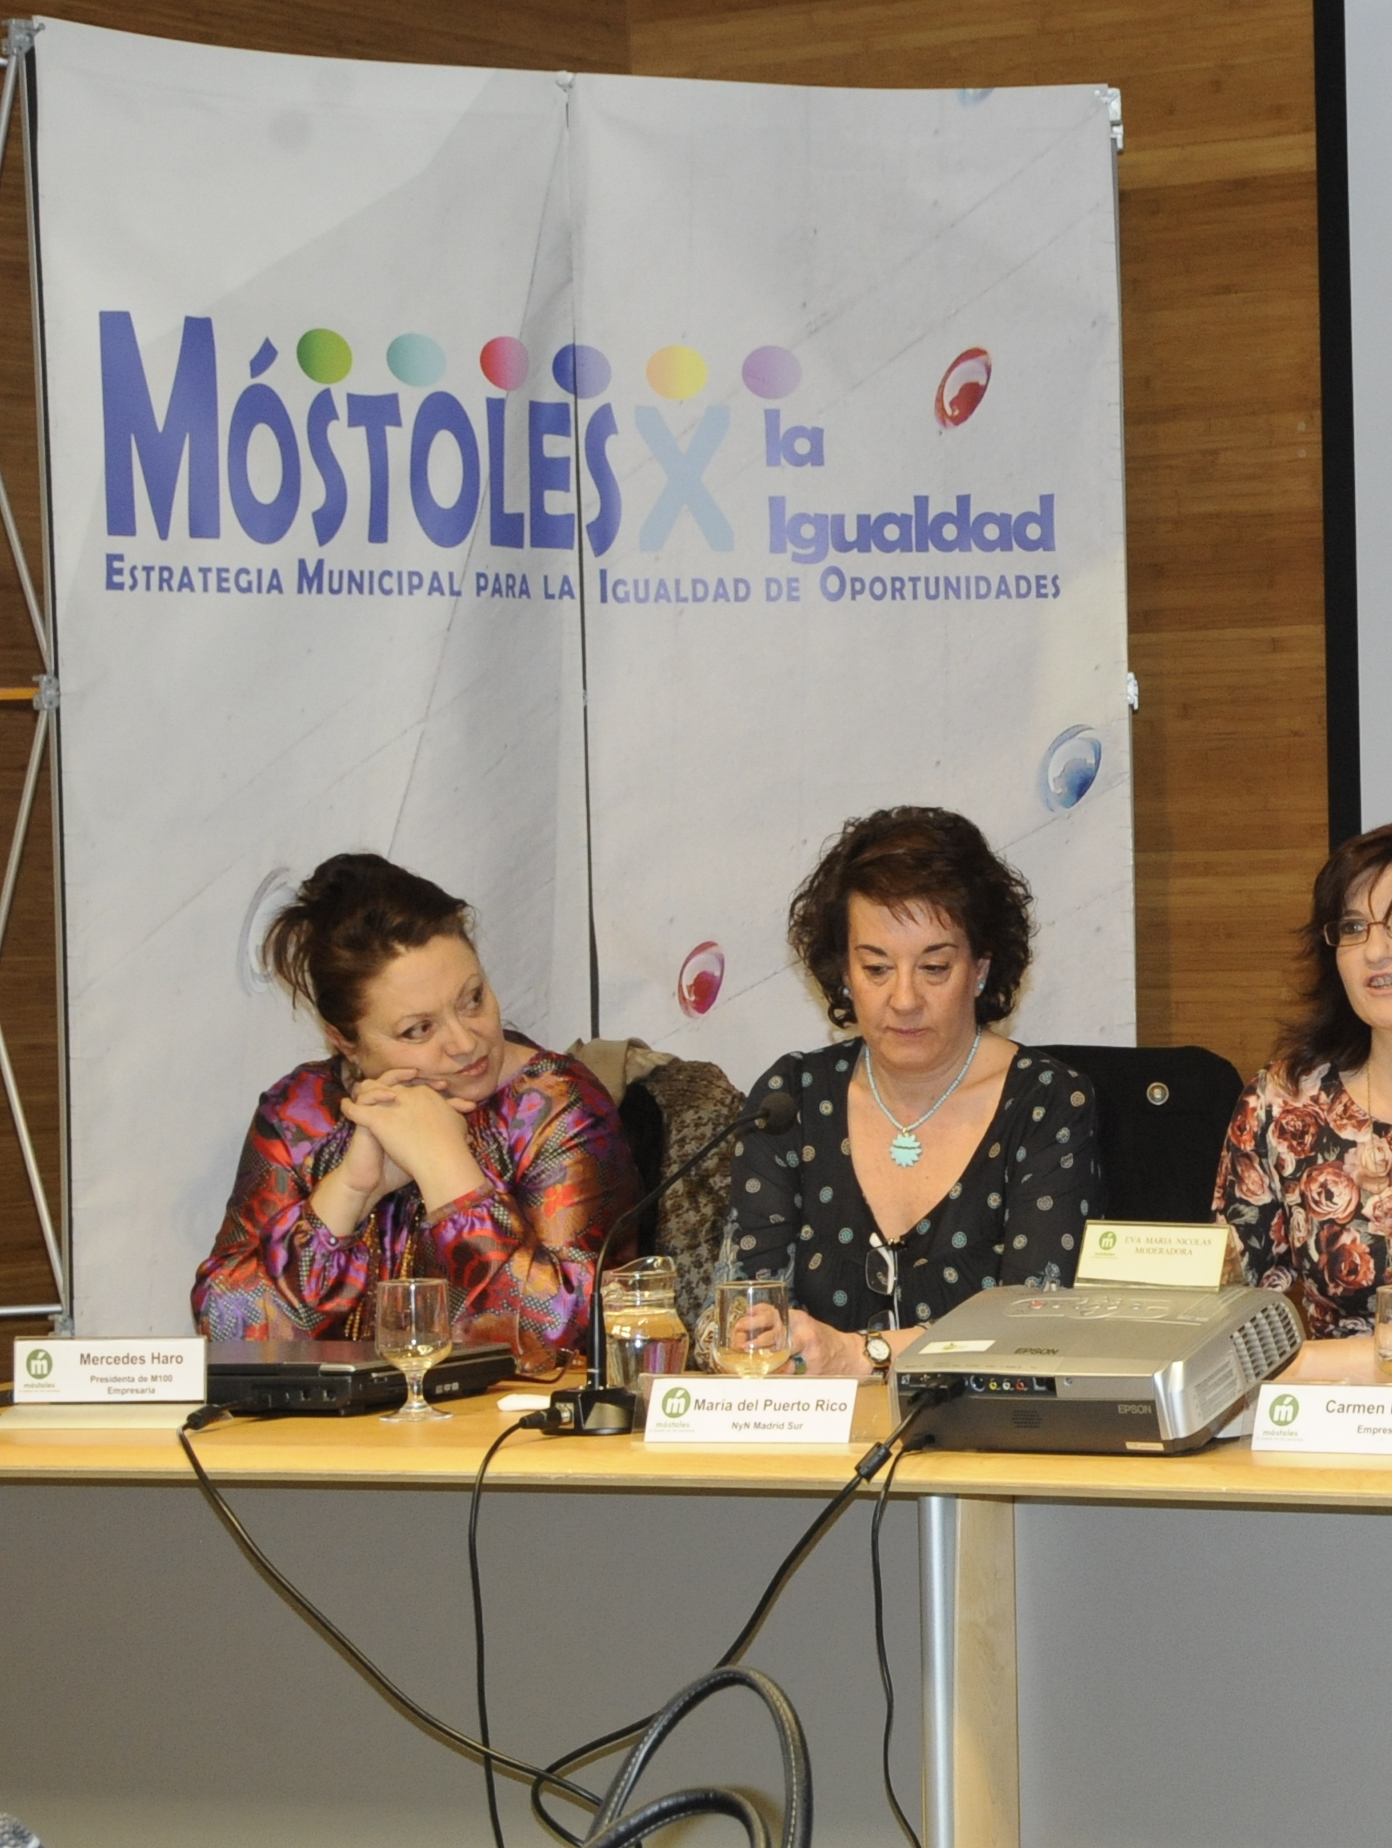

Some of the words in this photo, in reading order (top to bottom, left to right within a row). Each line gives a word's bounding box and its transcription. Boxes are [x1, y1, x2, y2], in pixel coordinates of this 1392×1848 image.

[99, 310, 622, 558] MÓSTOLES
[764, 408, 825, 468] la
[768, 493, 1056, 564] Igualdad
[105, 553, 283, 595] ESTRATEGIA
[297, 558, 462, 598] MUNICIPAL
[475, 570, 532, 599] PARA
[543, 571, 576, 600] LA
[600, 569, 752, 604] IGUALDAD
[766, 576, 800, 602] DE
[820, 565, 1061, 602] OPORTUNIDADES
[1124, 1236, 1141, 1245] EVA
[1135, 1246, 1193, 1256] MODERADORA
[1013, 1346, 1059, 1356] EPSON
[79, 1352, 147, 1366] Mercedes
[151, 1351, 184, 1366] Haro
[90, 1374, 135, 1384] Presidenta
[138, 1374, 148, 1384] de
[151, 1374, 173, 1384] M100
[107, 1386, 156, 1396] Empresaria
[737, 1398, 759, 1412] del
[762, 1398, 810, 1412] Puerto
[815, 1398, 848, 1413] Rico
[1117, 1403, 1152, 1415] EPSON
[1325, 1399, 1385, 1415] Carmen
[753, 1421, 785, 1431] Madrid
[787, 1421, 804, 1431] Sur
